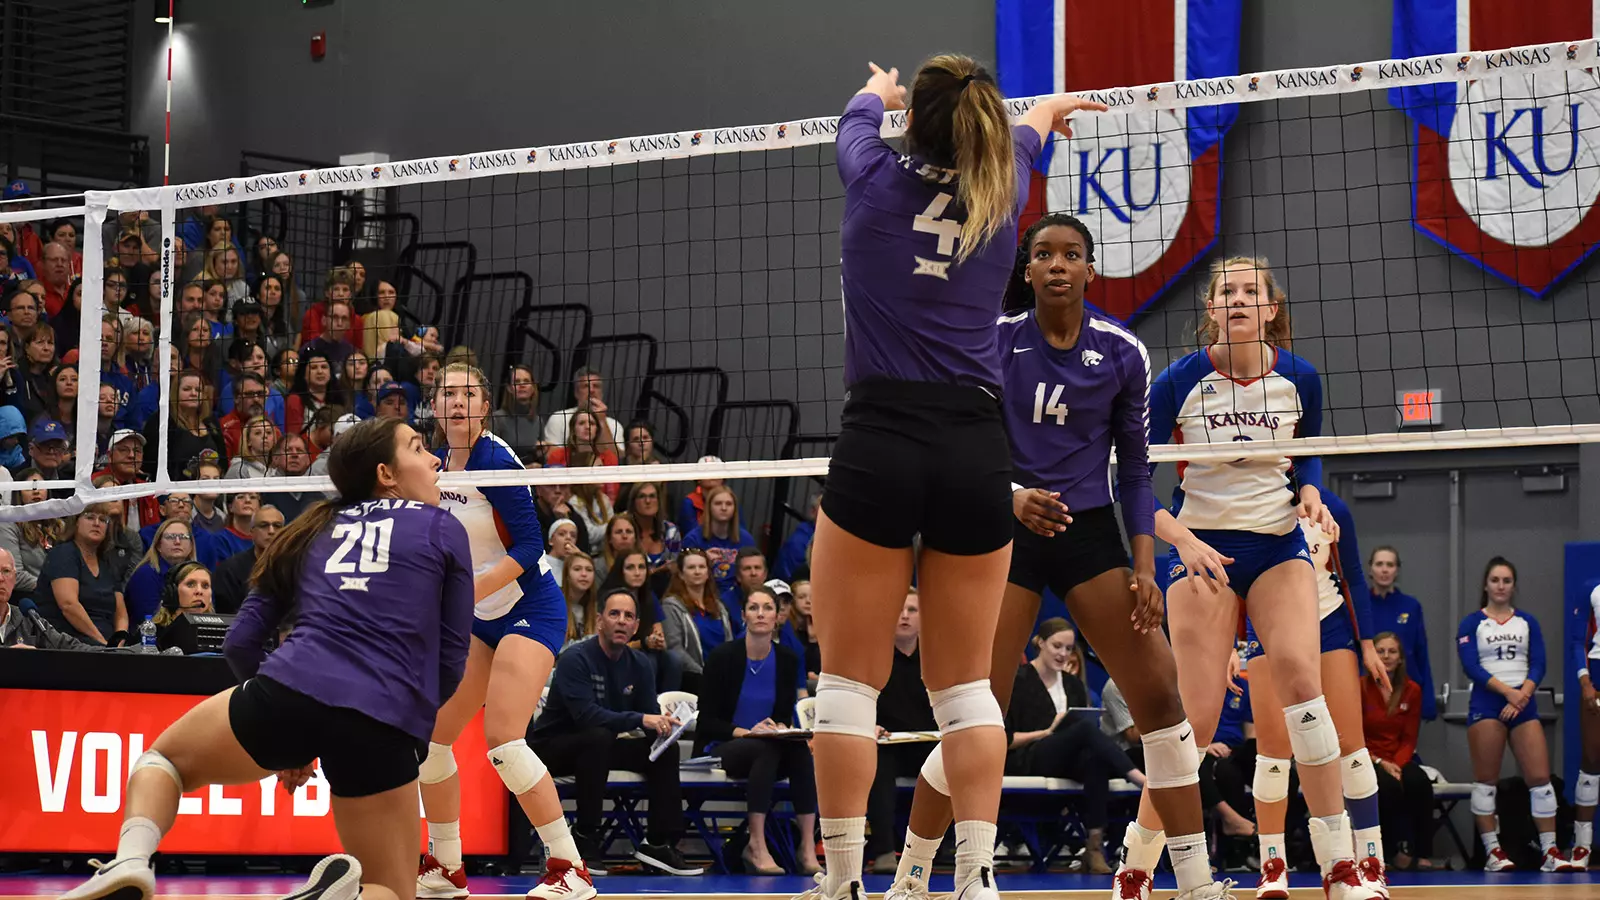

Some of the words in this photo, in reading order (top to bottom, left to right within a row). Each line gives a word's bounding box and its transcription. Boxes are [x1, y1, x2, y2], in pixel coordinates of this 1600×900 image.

[175, 184, 219, 201] KANSAS
[244, 175, 289, 193] KANSAS
[318, 168, 363, 185] KANSAS
[392, 160, 439, 178] KANSAS
[469, 152, 516, 170] KANSAS
[549, 143, 598, 161] KANSAS
[630, 134, 681, 152] KANSAS
[714, 127, 767, 145] KANSAS
[801, 118, 837, 136] KANS
[1175, 79, 1235, 99] KANSAS
[1275, 69, 1338, 89] KANSAS
[1378, 58, 1443, 79] KANSAS
[1486, 47, 1551, 70] KANSAS
[1479, 102, 1584, 189] KU
[1073, 140, 1168, 224] KU
[913, 192, 961, 256] 4
[1033, 382, 1068, 425] 14
[1207, 411, 1280, 430] KANSAS
[325, 517, 394, 573] 20
[1486, 634, 1522, 644] KANSAS
[1495, 645, 1517, 660] 15
